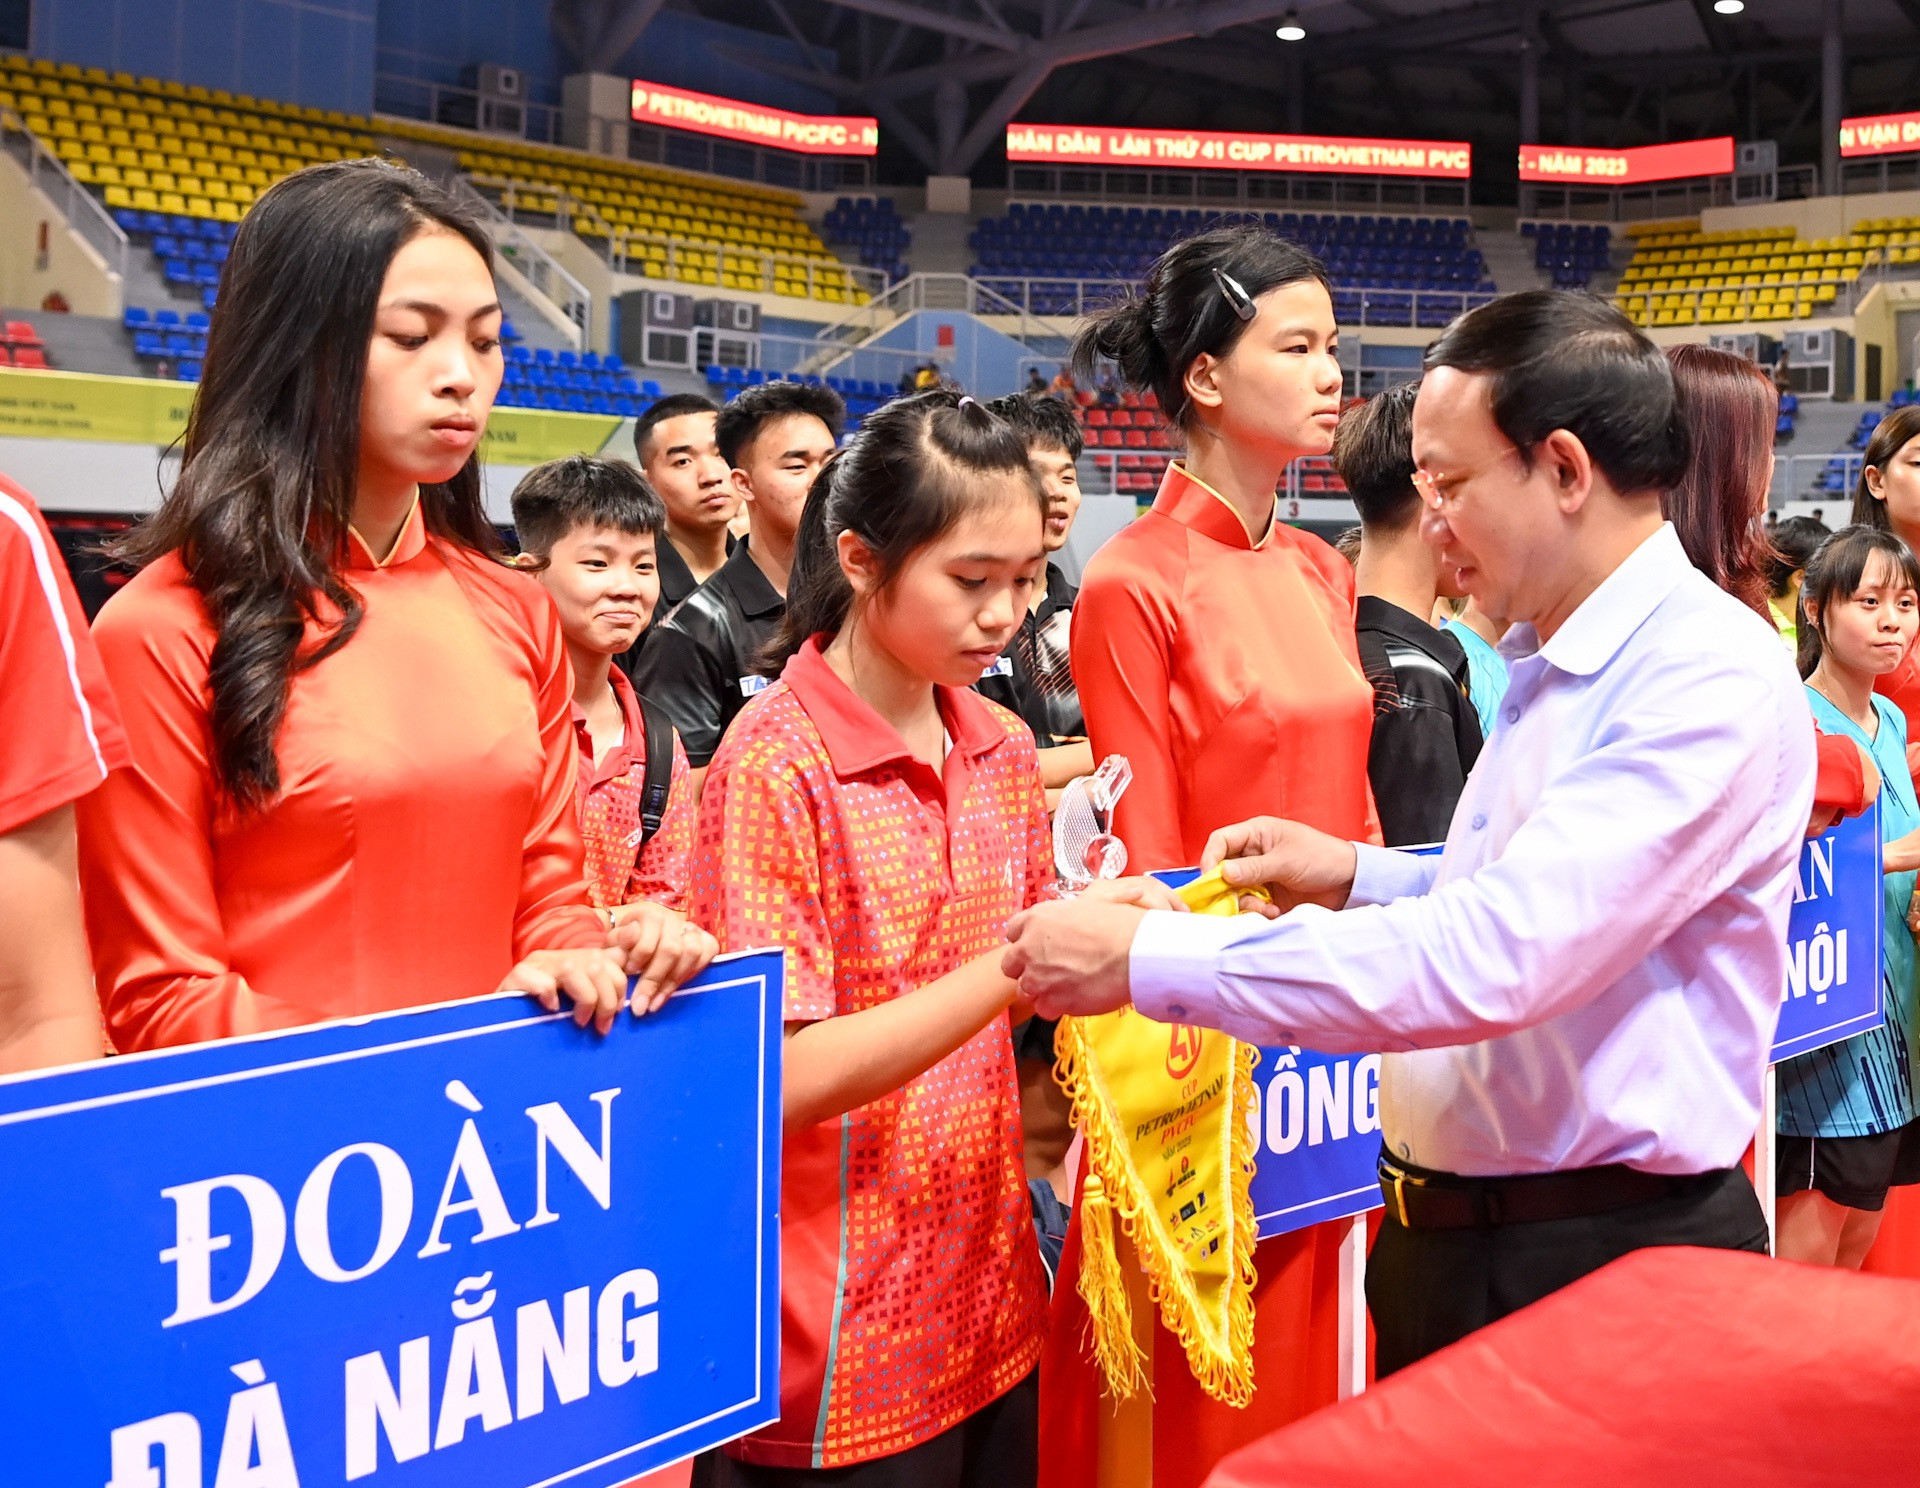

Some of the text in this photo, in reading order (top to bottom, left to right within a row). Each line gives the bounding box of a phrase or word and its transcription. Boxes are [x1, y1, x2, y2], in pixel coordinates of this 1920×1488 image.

[648, 92, 781, 138] PETROVIETNAM
[1201, 140, 1224, 160] 41
[1228, 141, 1271, 161] CUP
[1274, 143, 1425, 168] PETROVIETNAM
[1428, 150, 1470, 169] PVC
[1584, 155, 1627, 176] 2023
[1288, 501, 1299, 517] 3
[1782, 921, 1847, 1005] NỘI
[1136, 1074, 1223, 1142] PETROVIETNAM
[160, 1080, 621, 1329] ĐOÀN
[345, 1269, 660, 1482] NẴNG
